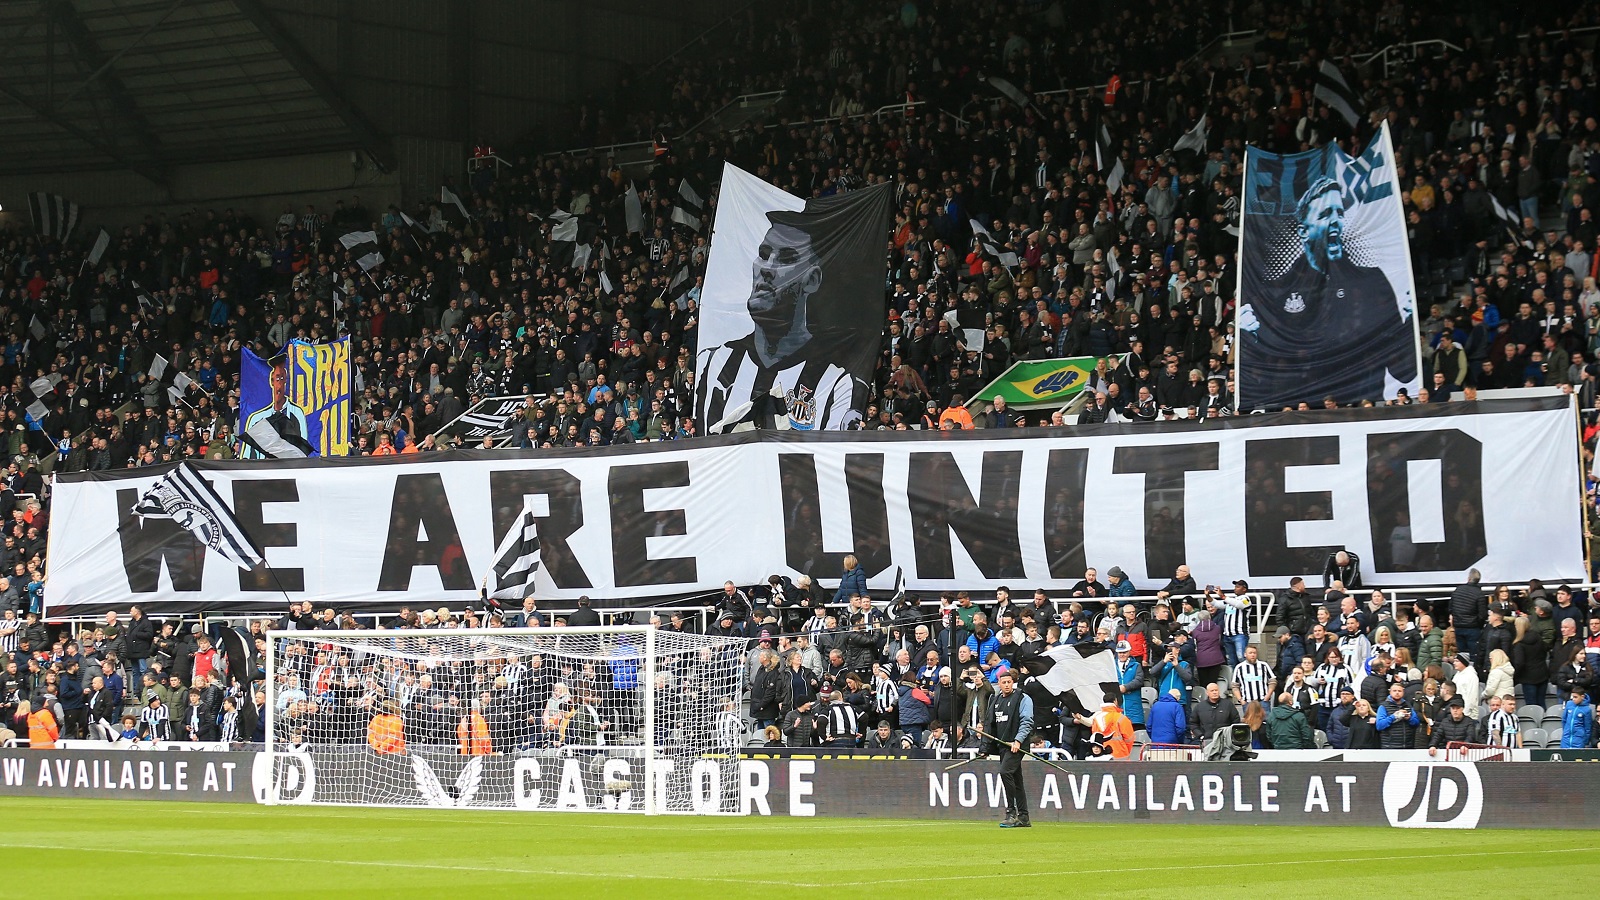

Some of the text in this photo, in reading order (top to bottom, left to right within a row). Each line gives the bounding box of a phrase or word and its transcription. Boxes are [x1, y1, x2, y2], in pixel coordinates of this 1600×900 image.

[288, 340, 349, 416] ISAK
[116, 427, 1487, 593] WE ARE UNITED
[37, 758, 189, 792] AVAILABLE
[203, 762, 236, 792] AT
[514, 757, 817, 817] CASTORE
[929, 772, 1357, 813] NOW AVAILABLE AT
[1397, 765, 1469, 823] JD
